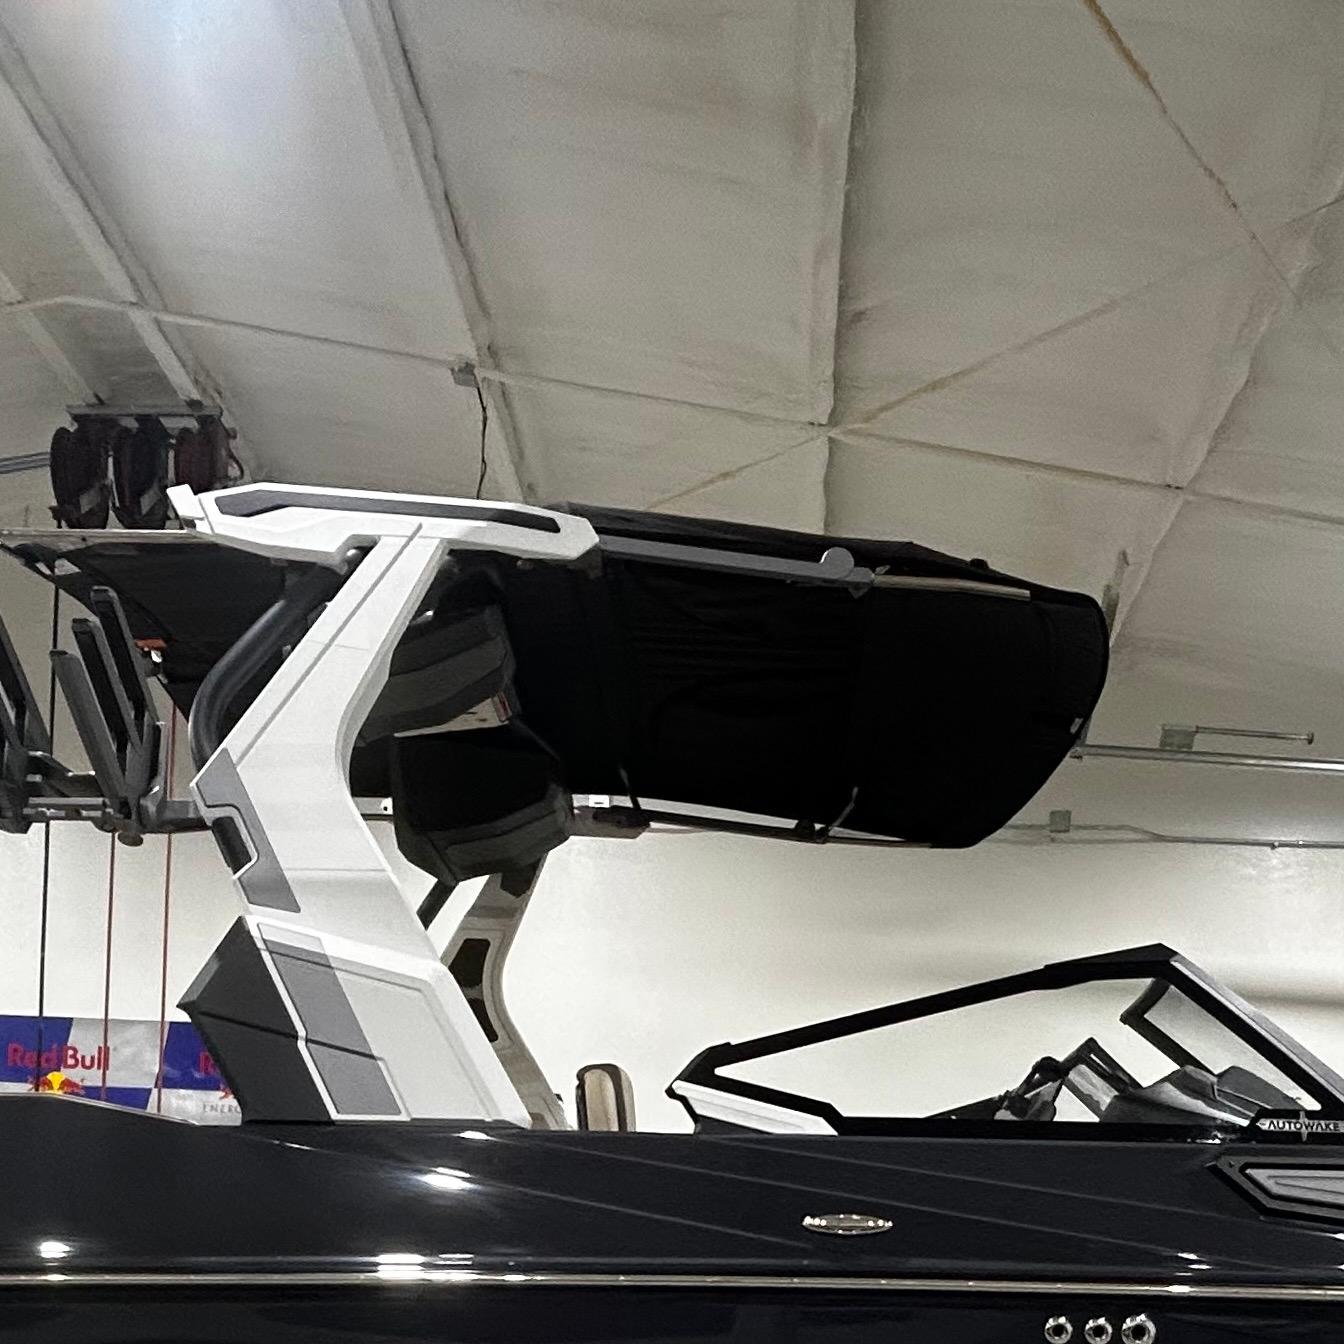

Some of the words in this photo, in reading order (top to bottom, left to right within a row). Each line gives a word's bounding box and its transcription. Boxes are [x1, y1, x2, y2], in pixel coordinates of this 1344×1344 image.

[7, 1043, 57, 1070] Red
[63, 1045, 110, 1071] Bull
[1267, 1120, 1340, 1132] AUTOWAKE
